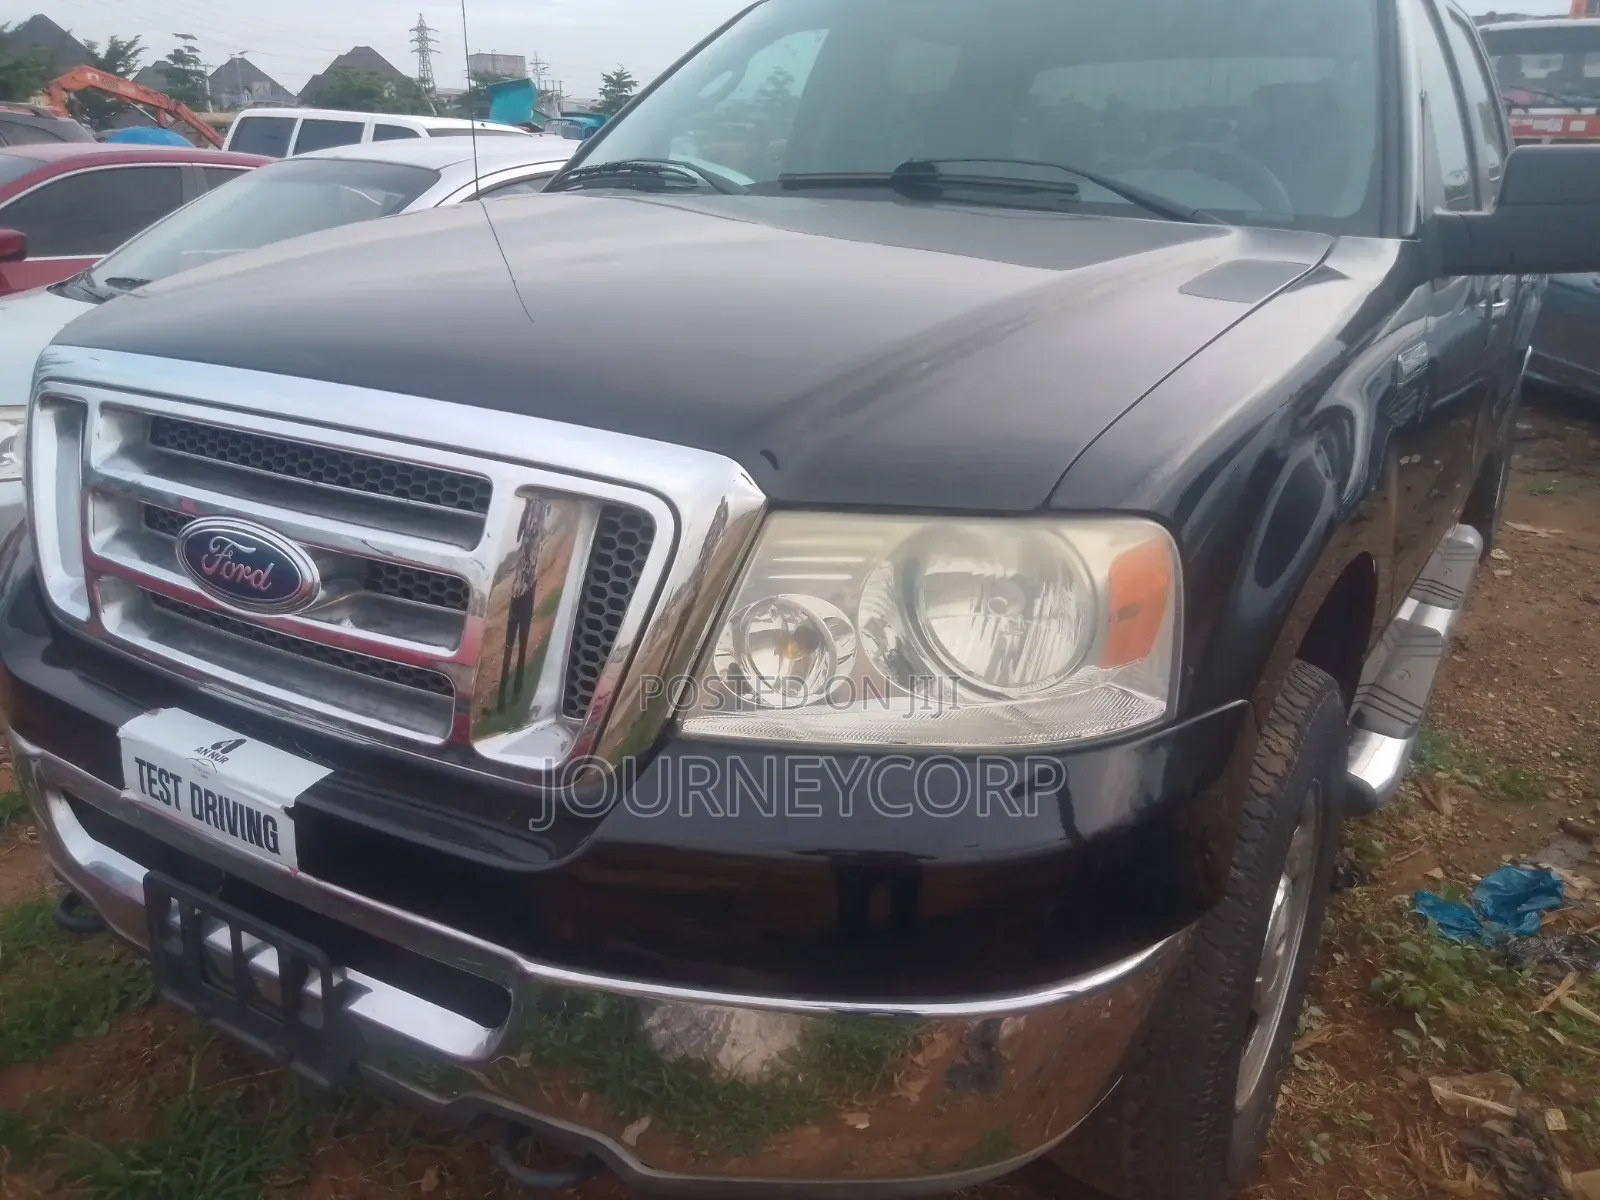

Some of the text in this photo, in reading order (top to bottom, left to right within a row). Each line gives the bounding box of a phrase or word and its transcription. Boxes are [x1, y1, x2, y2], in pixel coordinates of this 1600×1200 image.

[202, 535, 275, 592] Ford
[193, 746, 229, 764] AN NUR
[134, 756, 280, 856] TEST DRIVING
